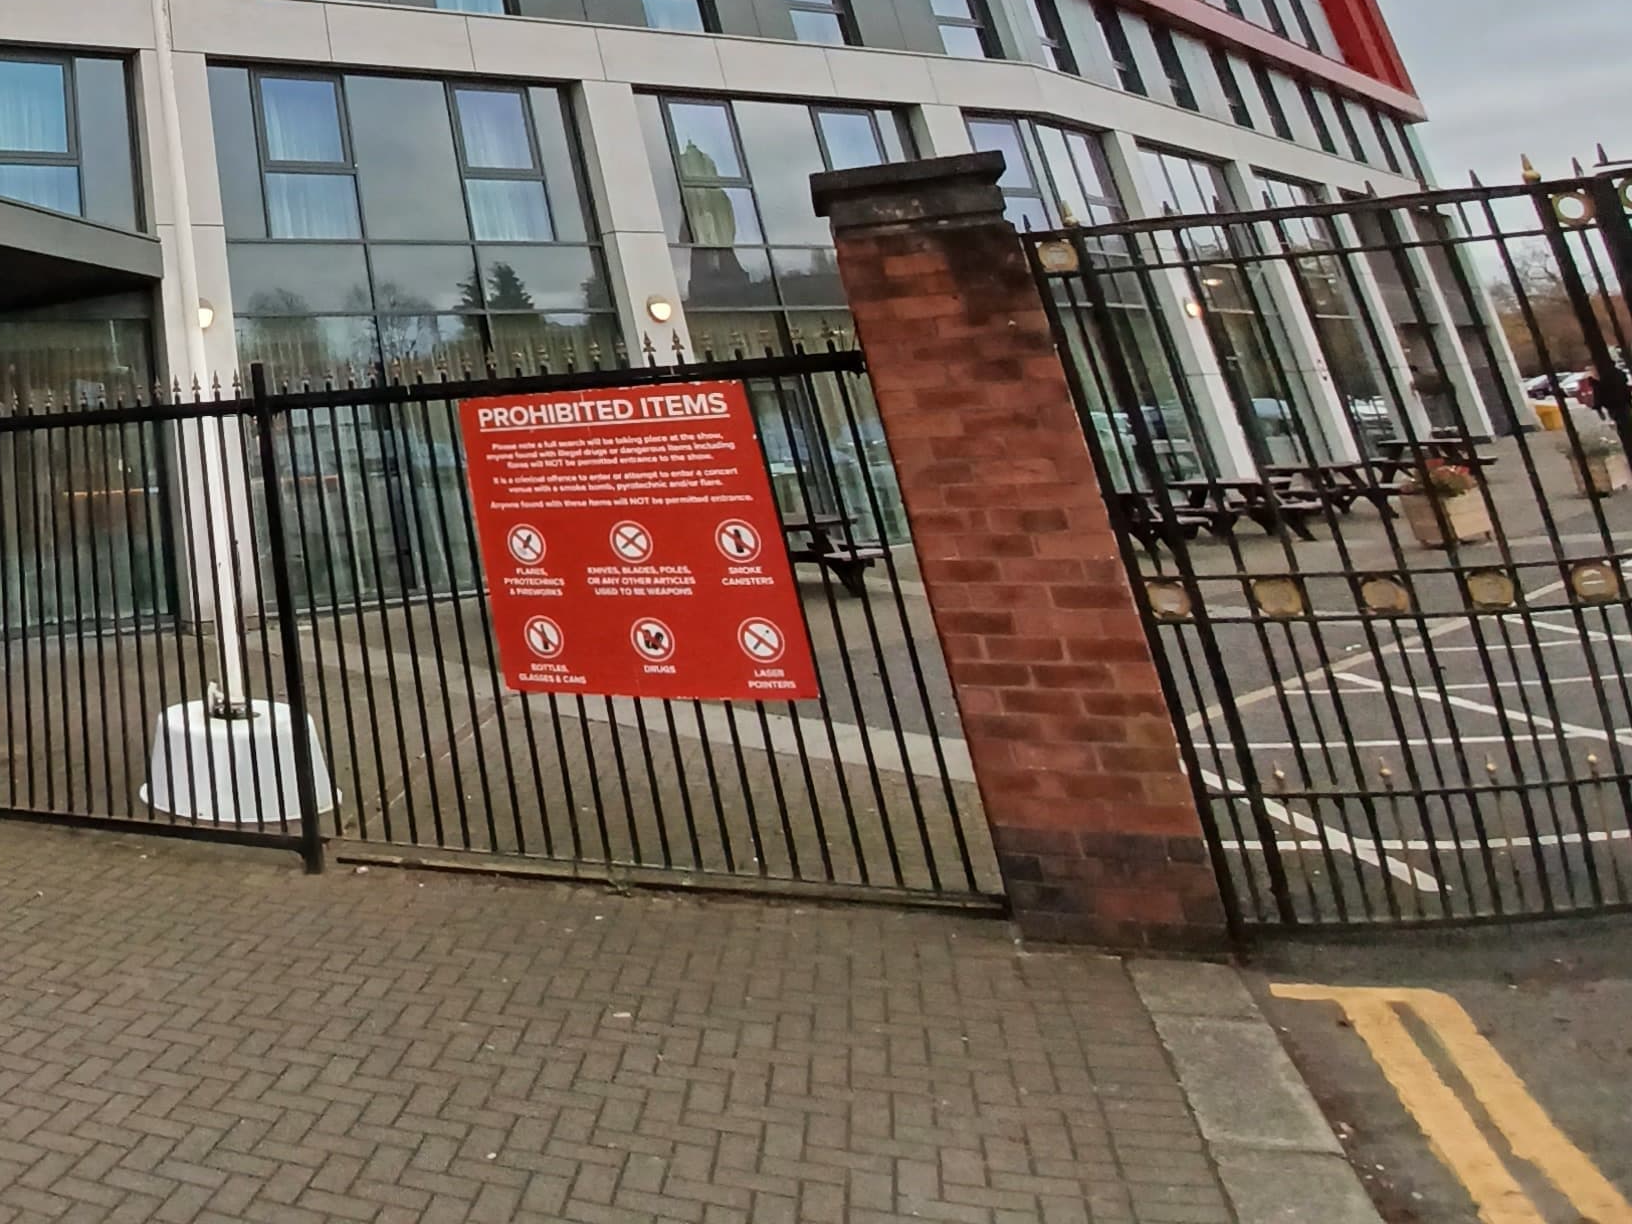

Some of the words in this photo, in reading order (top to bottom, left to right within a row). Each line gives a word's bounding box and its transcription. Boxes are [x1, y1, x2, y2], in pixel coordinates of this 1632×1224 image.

[478, 399, 634, 427] PROHIBITED
[639, 392, 728, 418] ITEMS
[544, 459, 563, 467] NOT
[629, 496, 649, 505] NOT
